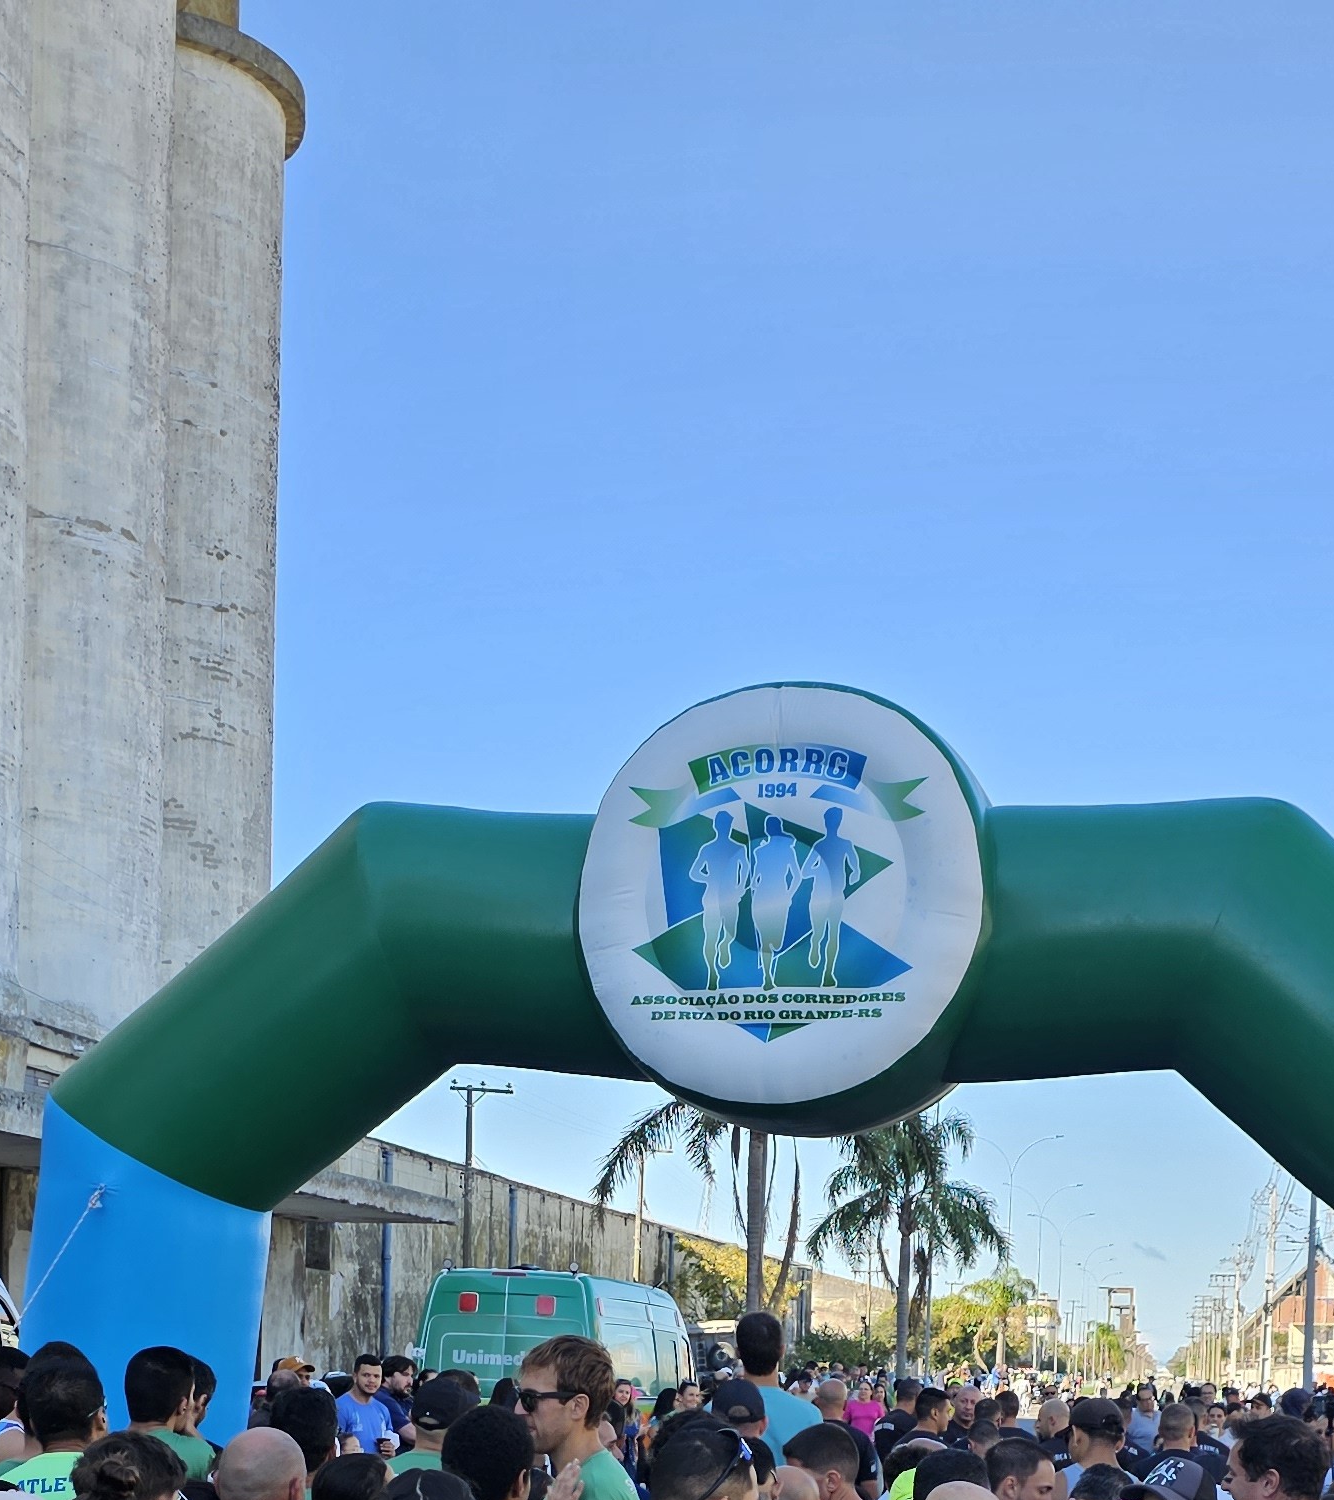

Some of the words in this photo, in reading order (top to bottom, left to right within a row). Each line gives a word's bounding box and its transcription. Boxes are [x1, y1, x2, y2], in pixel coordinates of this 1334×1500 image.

[708, 747, 850, 785] ACORRG
[757, 783, 797, 798] 1994
[630, 992, 740, 1008] ASSOCIAÇÃO
[743, 993, 779, 1004] DOS
[781, 991, 906, 1005] CORREDORES
[651, 1010, 676, 1021] DE
[678, 1010, 715, 1021] RUA
[717, 1010, 742, 1021] DO
[744, 1010, 776, 1020] RIO
[778, 1008, 882, 1020] GRANDE-RS
[451, 1349, 525, 1366] Unimed
[17, 1476, 75, 1494] ATLE
